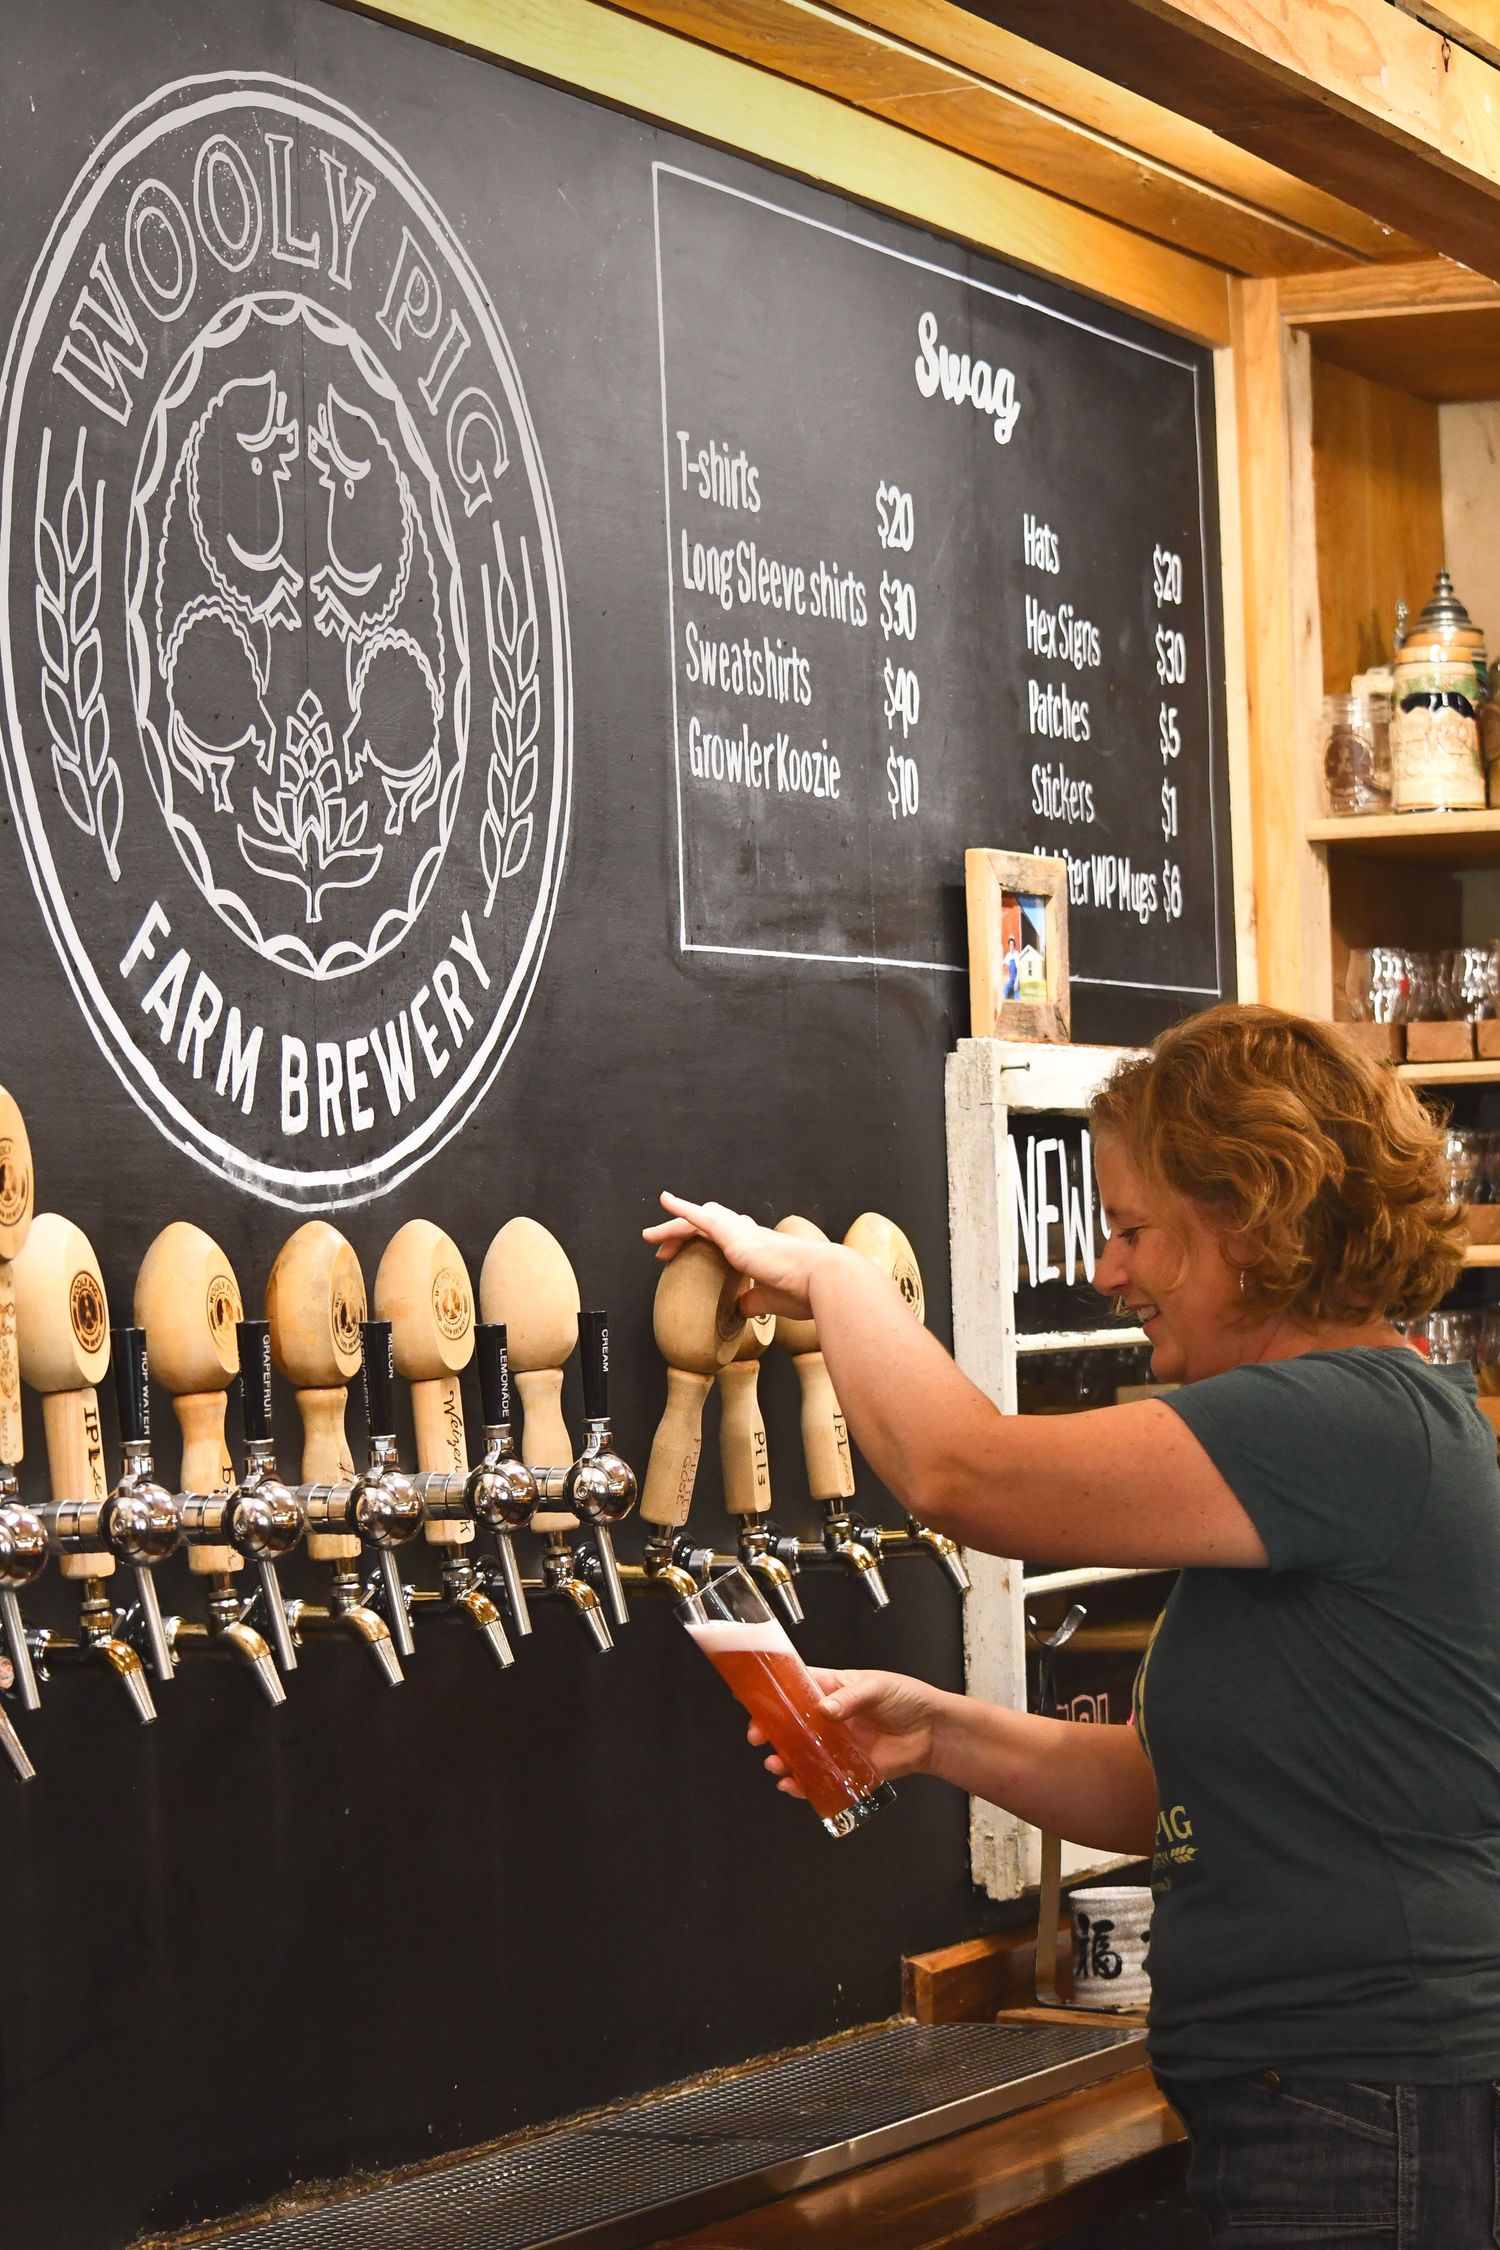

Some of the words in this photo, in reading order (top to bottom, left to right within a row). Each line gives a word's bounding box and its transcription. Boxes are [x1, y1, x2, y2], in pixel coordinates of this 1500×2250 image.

[52, 133, 376, 426] WOOLY
[376, 227, 510, 518] PIG
[914, 311, 1021, 445] Swag
[676, 430, 761, 513] T-shirts
[875, 480, 914, 552] $20
[809, 560, 868, 628] shirts
[879, 569, 917, 641] $30
[1023, 513, 1060, 574] Hats
[1153, 543, 1183, 608] $20
[685, 621, 812, 706] Sweatshirts
[883, 657, 920, 739] $40
[1025, 594, 1058, 659] Hex
[1058, 604, 1101, 671] Signs
[1155, 623, 1187, 685] $30
[1028, 679, 1091, 742] Patches
[1159, 701, 1182, 766] $5
[886, 746, 920, 820] $10
[1031, 762, 1096, 824] Stickers
[1161, 777, 1179, 843] $1
[1118, 857, 1159, 925] Mugs
[1162, 859, 1183, 924] $8
[119, 901, 264, 1115] FARM
[281, 911, 492, 1136] BREWERY
[141, 1351, 149, 1381] HOP
[262, 1334, 272, 1420] GRAPEFRUIT
[499, 1348, 510, 1418] LEMONADE
[601, 1328, 609, 1373] CREAM
[142, 1385, 150, 1435] WATER
